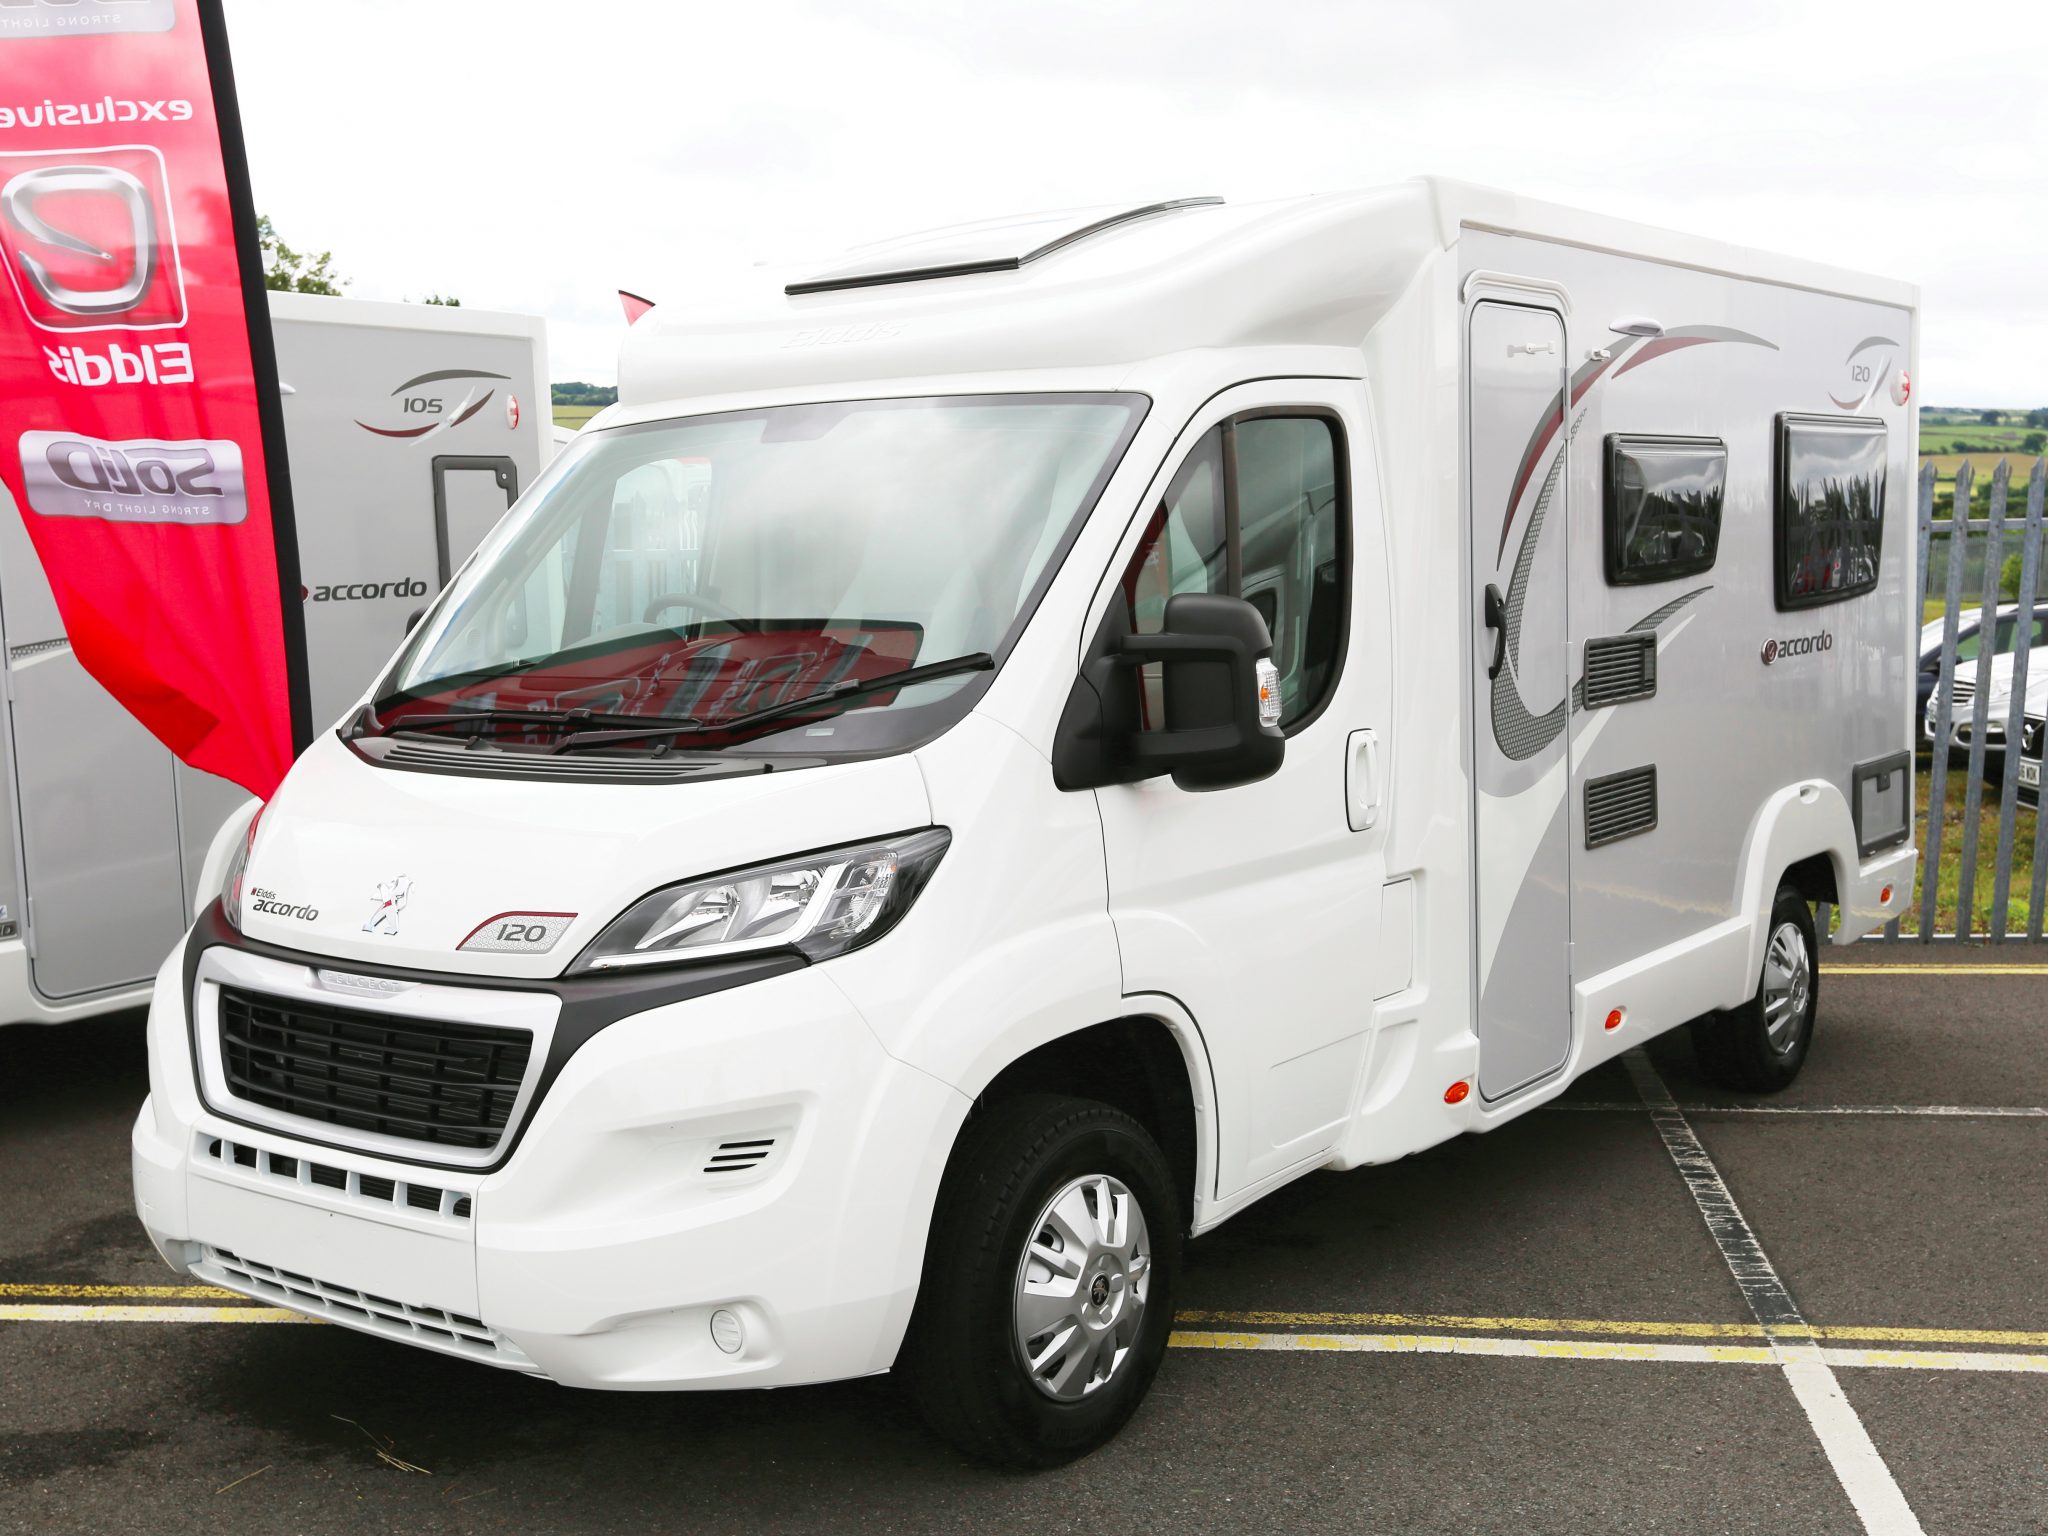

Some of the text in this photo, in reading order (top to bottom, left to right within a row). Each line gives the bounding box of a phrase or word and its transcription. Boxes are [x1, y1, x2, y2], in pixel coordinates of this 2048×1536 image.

[1851, 365, 1871, 383] 120
[313, 577, 428, 602] accordo
[1777, 629, 1833, 659] accordo
[256, 887, 277, 900] Elddis
[252, 899, 320, 922] accordo
[496, 922, 548, 943] 120
